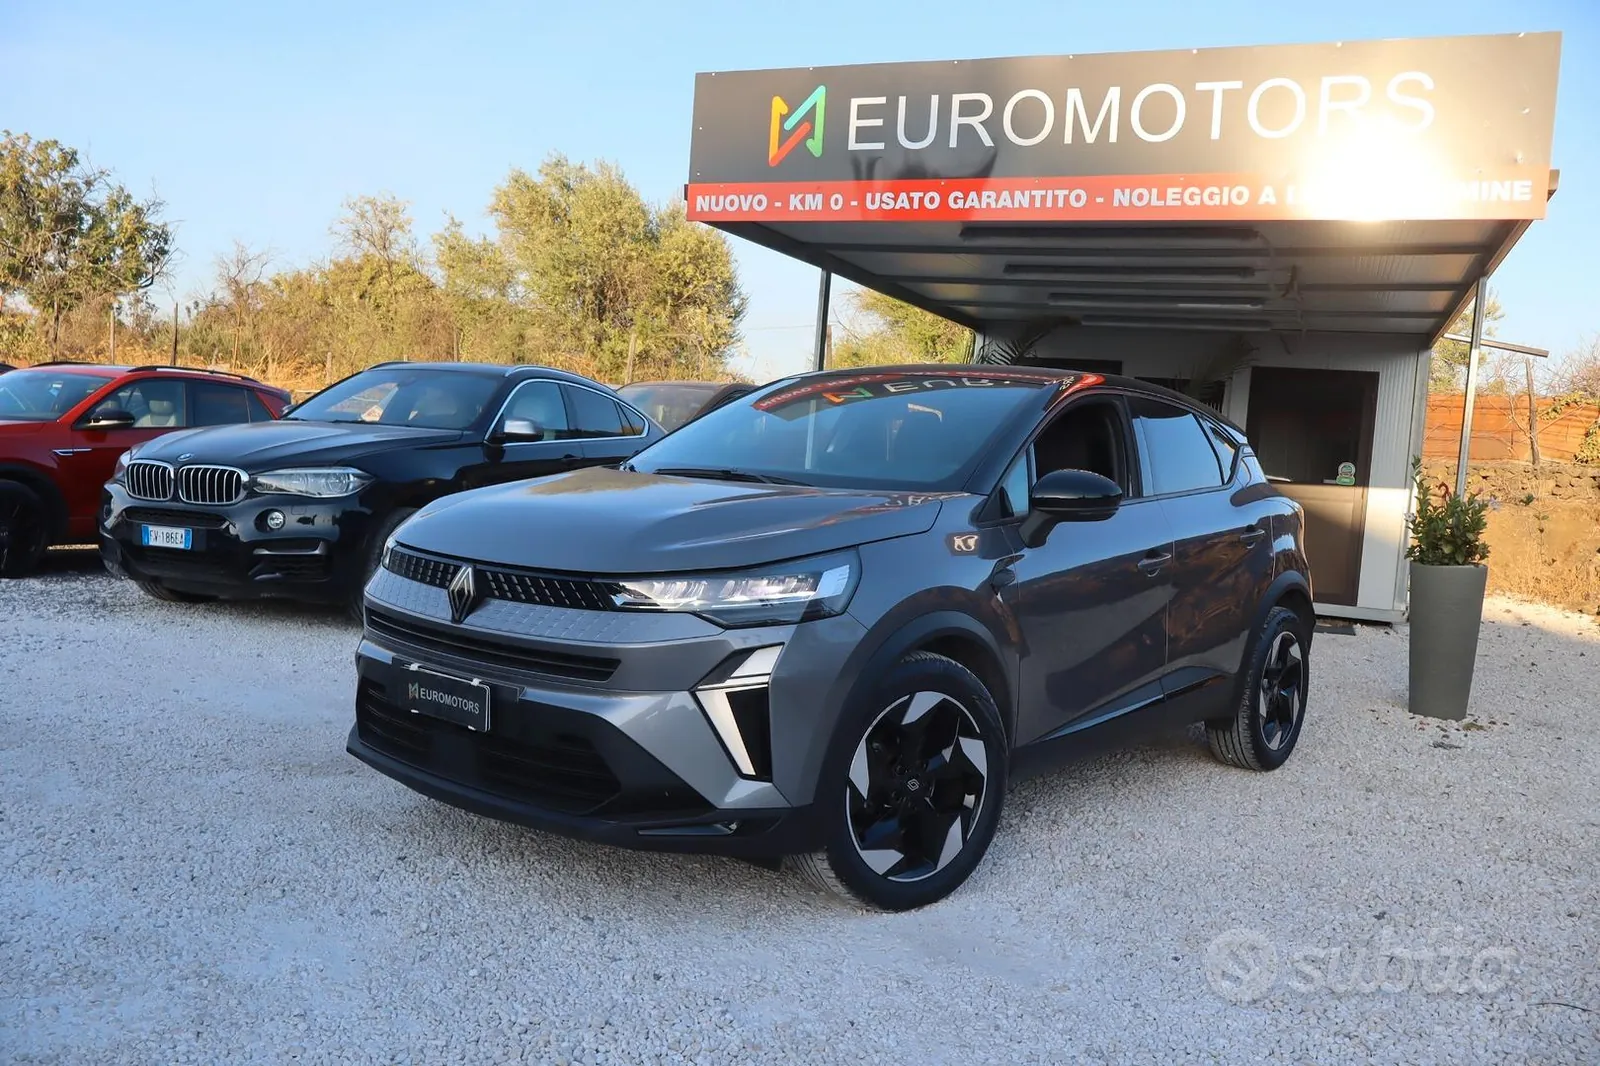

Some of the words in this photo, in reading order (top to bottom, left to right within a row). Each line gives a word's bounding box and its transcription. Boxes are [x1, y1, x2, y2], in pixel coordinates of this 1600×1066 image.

[848, 71, 1436, 151] EUROMOTORS
[696, 194, 768, 212] NUOVO
[789, 193, 823, 211] KM
[830, 194, 843, 210] 0
[866, 192, 941, 209] USATO
[949, 189, 1087, 209] GARANTITO
[1112, 185, 1249, 207] NOLEGGIO
[1258, 185, 1277, 205] A
[420, 688, 480, 714] EUROMOTORS
